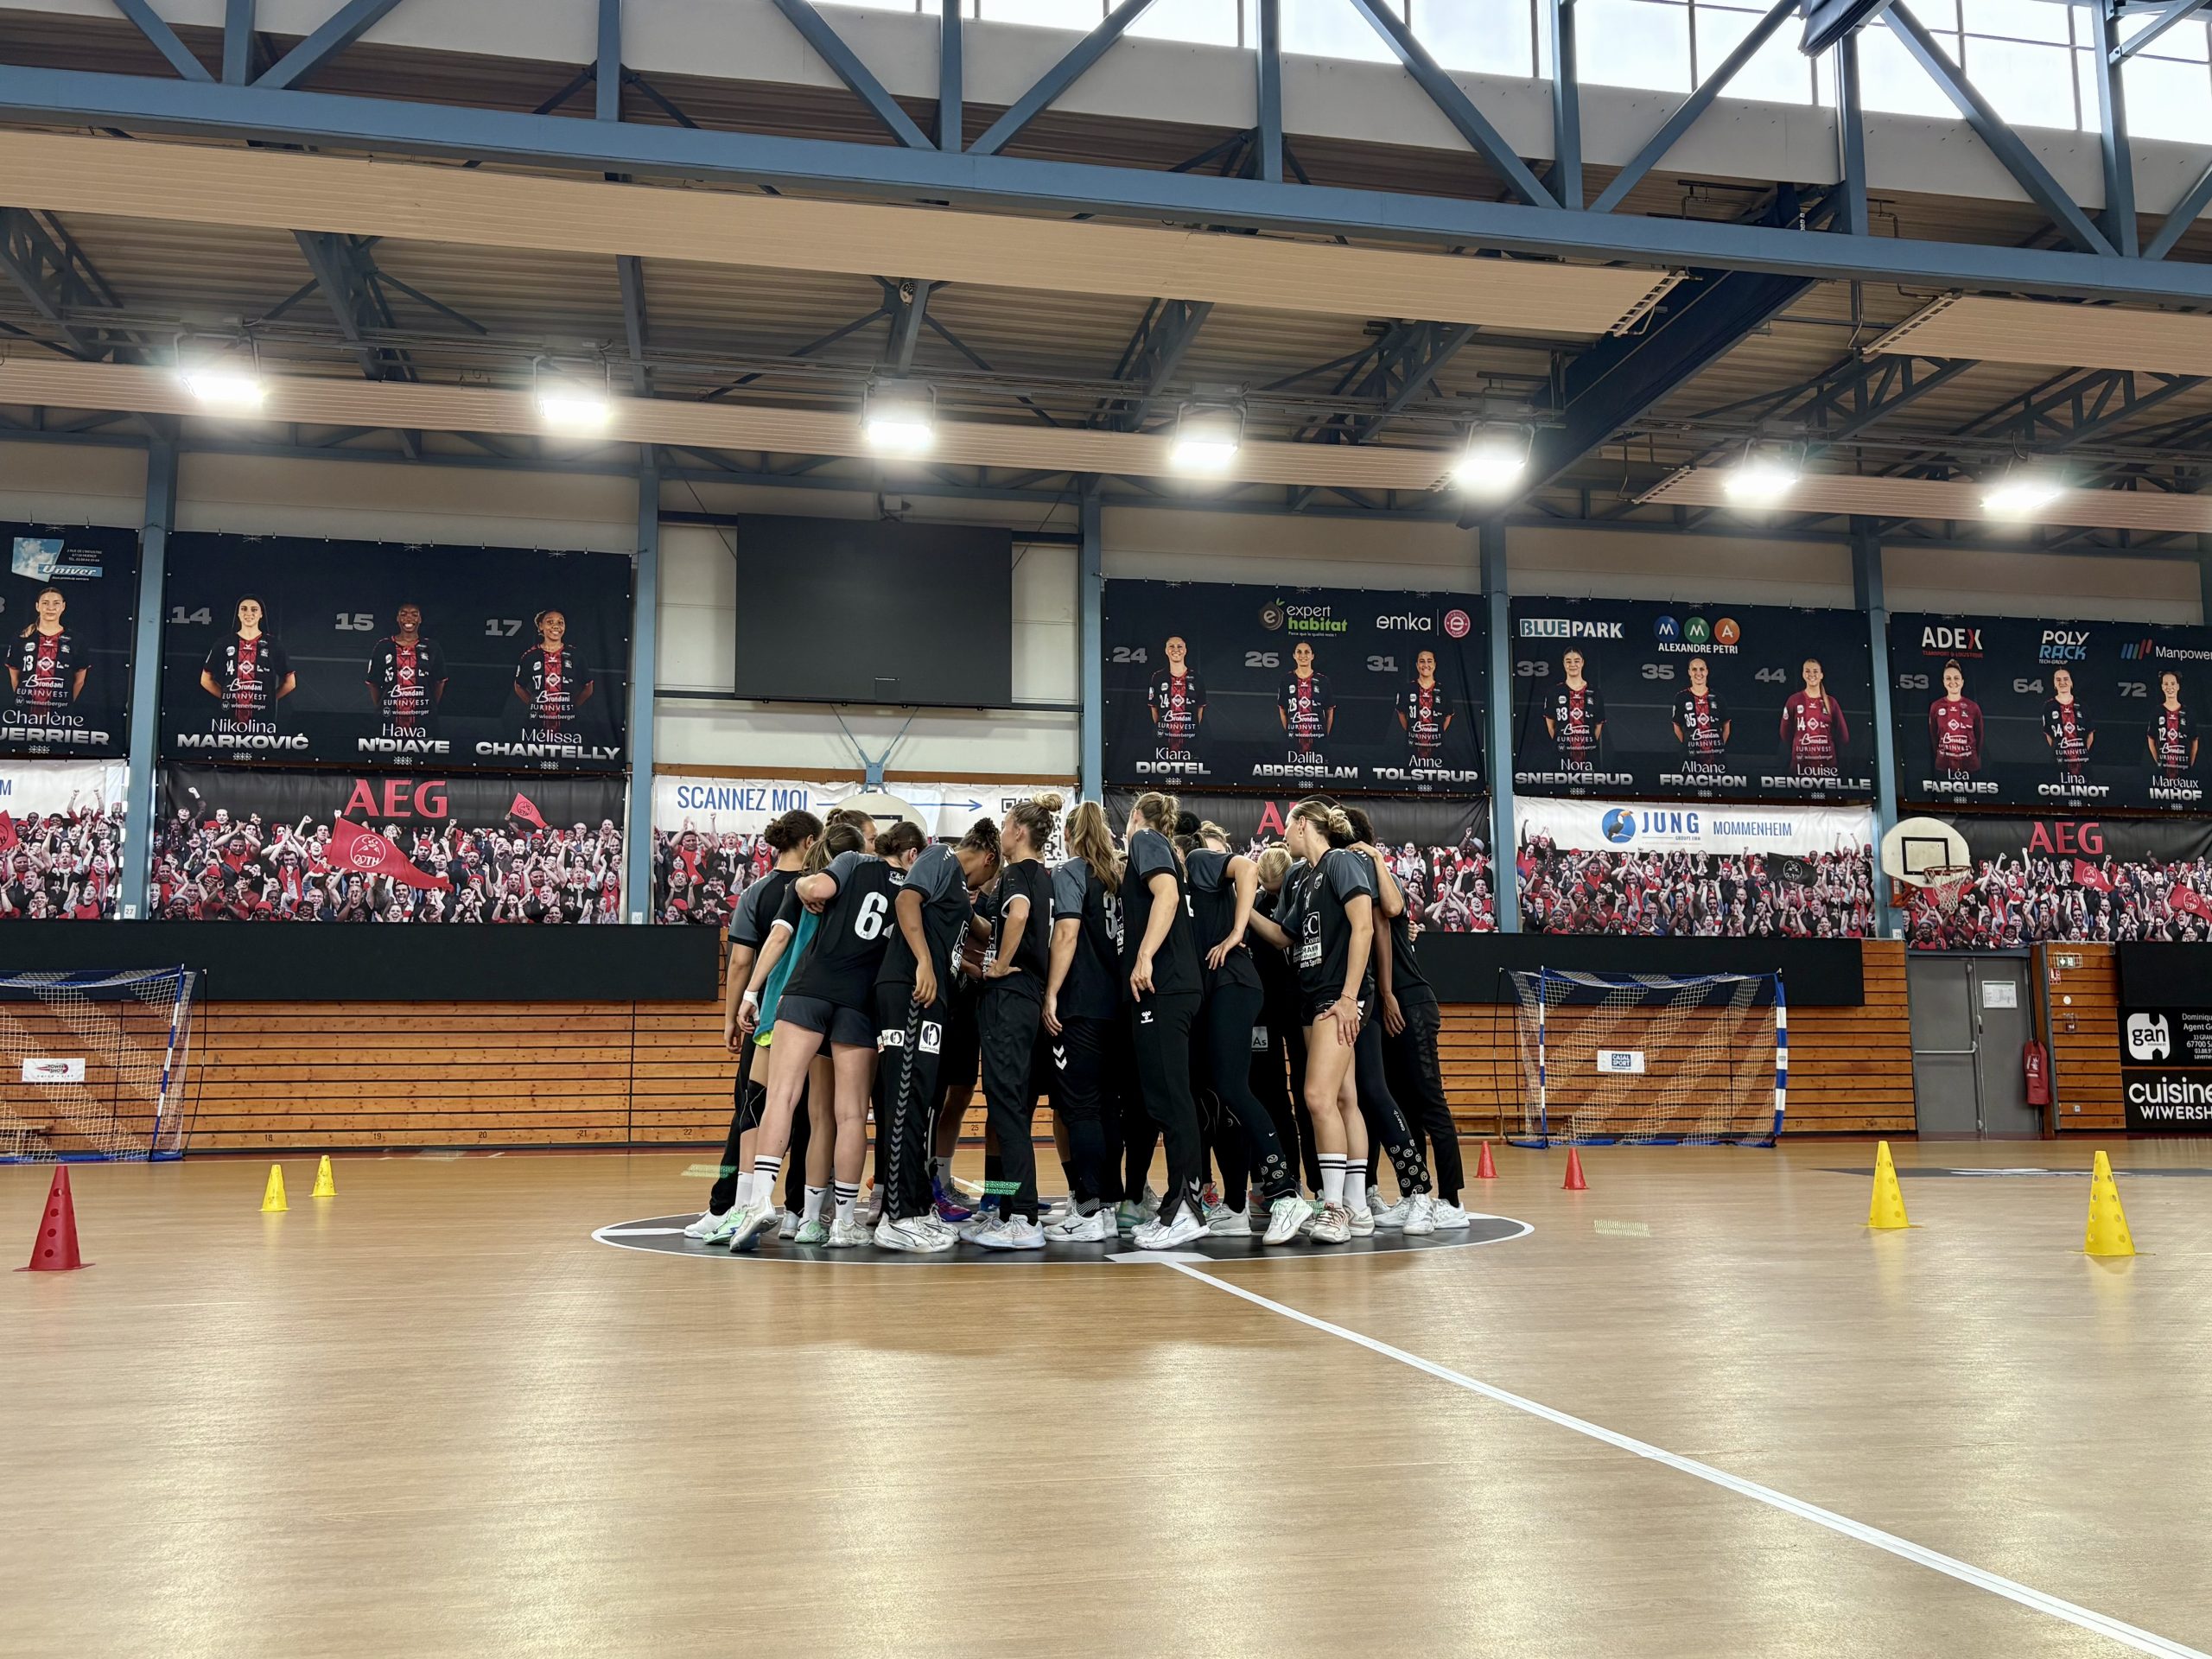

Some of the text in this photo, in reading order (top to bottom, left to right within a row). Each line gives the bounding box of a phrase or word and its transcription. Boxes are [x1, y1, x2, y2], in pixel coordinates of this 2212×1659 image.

[42, 564, 97, 576] Univer
[172, 606, 212, 625] 14
[1287, 606, 1332, 619] expert
[334, 613, 374, 631] 15
[486, 619, 523, 637] 17
[1288, 616, 1348, 632] habitat
[1376, 612, 1432, 631] emka
[1921, 626, 1983, 650] ADEX
[2042, 630, 2090, 645] POLY
[1113, 646, 1147, 664] 24
[1658, 643, 1738, 654] ALEXANDRE PETRI
[2039, 645, 2087, 660] RACK
[22, 655, 34, 671] 13
[1245, 651, 1280, 668] 26
[1367, 655, 1399, 672] 31
[1517, 660, 1549, 677] 33
[1642, 664, 1675, 680] 35
[1755, 667, 1786, 683] 44
[22, 674, 65, 689] Brondani
[226, 678, 263, 691] Brondani
[1900, 674, 1929, 690] 53
[2013, 678, 2044, 694] 64
[16, 688, 69, 698] EURINVEST
[388, 684, 424, 697] Brondani
[536, 690, 570, 702] Brondani
[2118, 682, 2146, 697] 72
[3, 709, 84, 727] Charlène
[1409, 705, 1416, 719] 31
[211, 718, 276, 734] Nikolina
[1684, 713, 1696, 728] 35
[382, 723, 426, 737] Hawa
[522, 728, 582, 744] Mélissa
[177, 733, 308, 750] MARKOVIĆ
[358, 737, 450, 754] N'DIAYE
[475, 741, 620, 760] CHANTELLY
[1155, 747, 1191, 760] Kiara
[1287, 751, 1324, 764] Dalila
[1135, 761, 1211, 775] DIOTEL
[1408, 754, 1442, 768] Anne
[1560, 759, 1592, 772] Nora
[1681, 760, 1726, 773] Albane
[1252, 764, 1358, 779] ABDESSELAM
[1372, 766, 1478, 783] TOLSTRUP
[1796, 763, 1838, 777] Louise
[1948, 768, 1969, 780] Léa
[1515, 772, 1633, 785] SNEDKERUD
[1659, 773, 1747, 788] FRACHON
[1761, 776, 1872, 791] DENOYELLE
[2061, 772, 2085, 784] Lina
[2152, 775, 2198, 790] Margaux
[1923, 780, 1999, 794] FARGUES
[2037, 784, 2109, 798] COLINOT
[2149, 787, 2202, 801] IMHOF
[344, 779, 448, 817] AEG
[677, 785, 808, 811] SCANNEZ MOI
[1642, 811, 1792, 836] JUNG MOMMENHEIM
[2029, 822, 2103, 855] AEG
[855, 891, 894, 940] 6
[2183, 1023, 2204, 1032] Agent
[2133, 1029, 2166, 1046] gan
